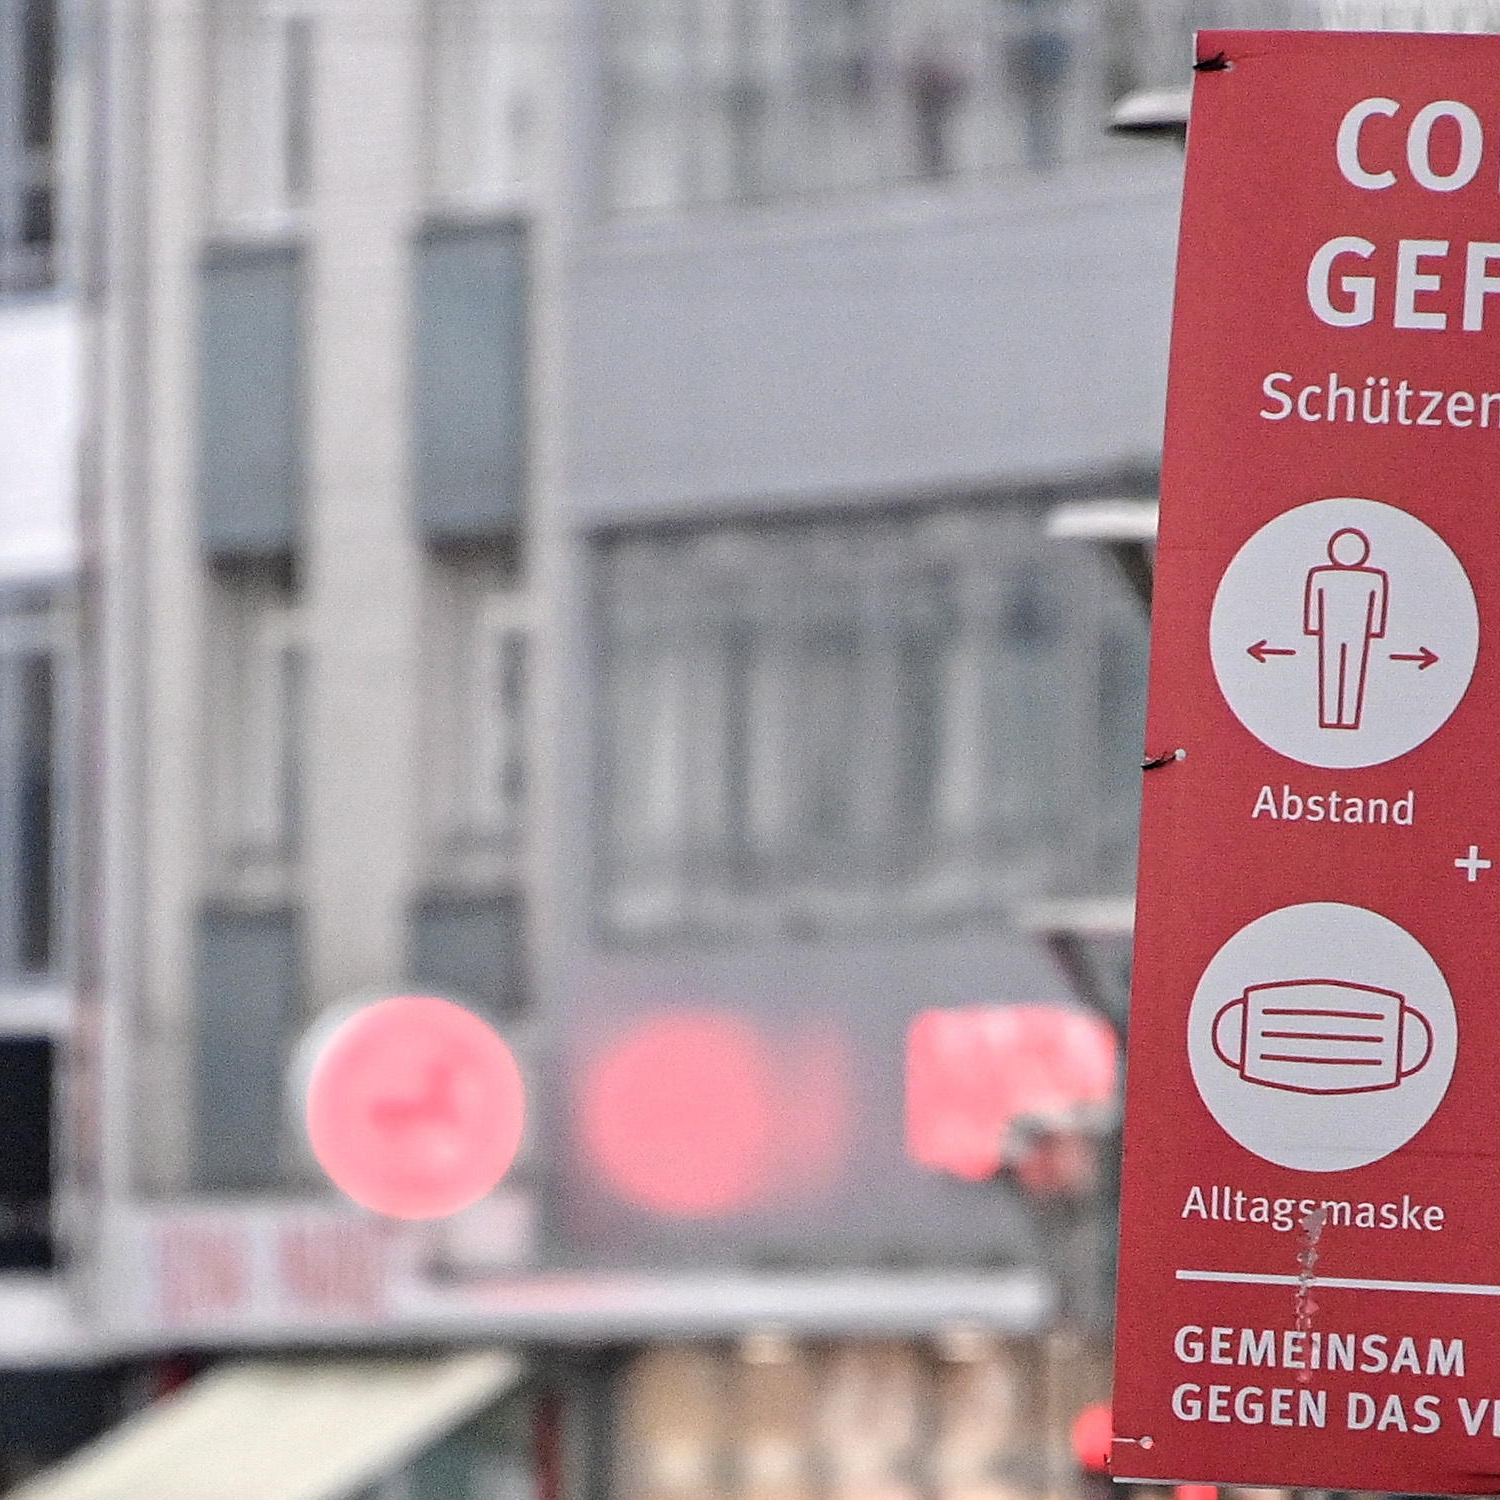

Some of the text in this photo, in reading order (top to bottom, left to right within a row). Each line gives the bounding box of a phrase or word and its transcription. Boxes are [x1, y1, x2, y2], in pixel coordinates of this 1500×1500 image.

[1252, 784, 1414, 827] Abstand
[1182, 1185, 1445, 1233] Alltagsmaske
[1174, 1325, 1465, 1377] GEMEINSAM
[1171, 1383, 1327, 1428] GEGEN
[1347, 1392, 1441, 1434] DAS
